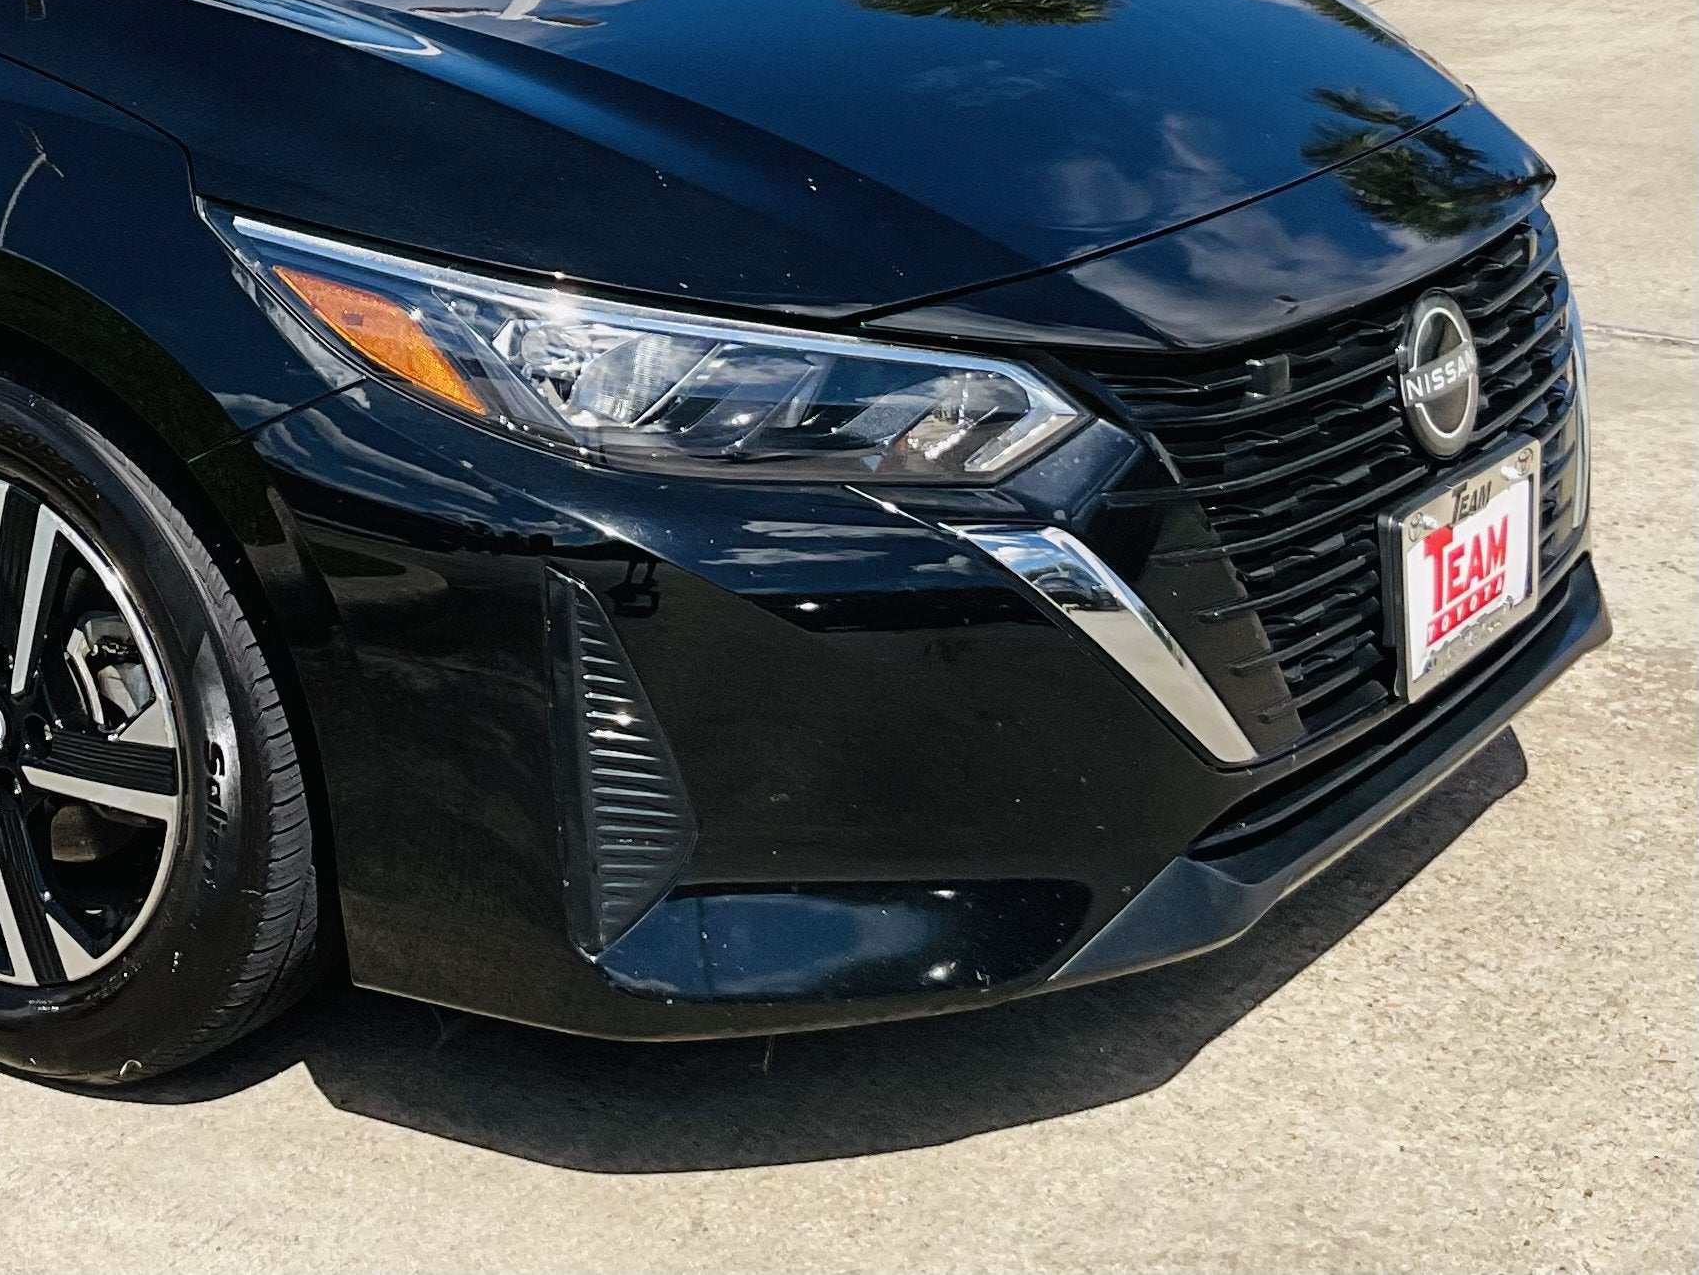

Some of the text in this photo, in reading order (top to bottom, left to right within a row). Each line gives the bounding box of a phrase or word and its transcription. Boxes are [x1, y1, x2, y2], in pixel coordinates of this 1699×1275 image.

[1406, 347, 1474, 401] NISSAN
[1451, 481, 1492, 525] TEAM
[1424, 515, 1508, 615] TEAM
[1427, 578, 1505, 643] TOYOTA
